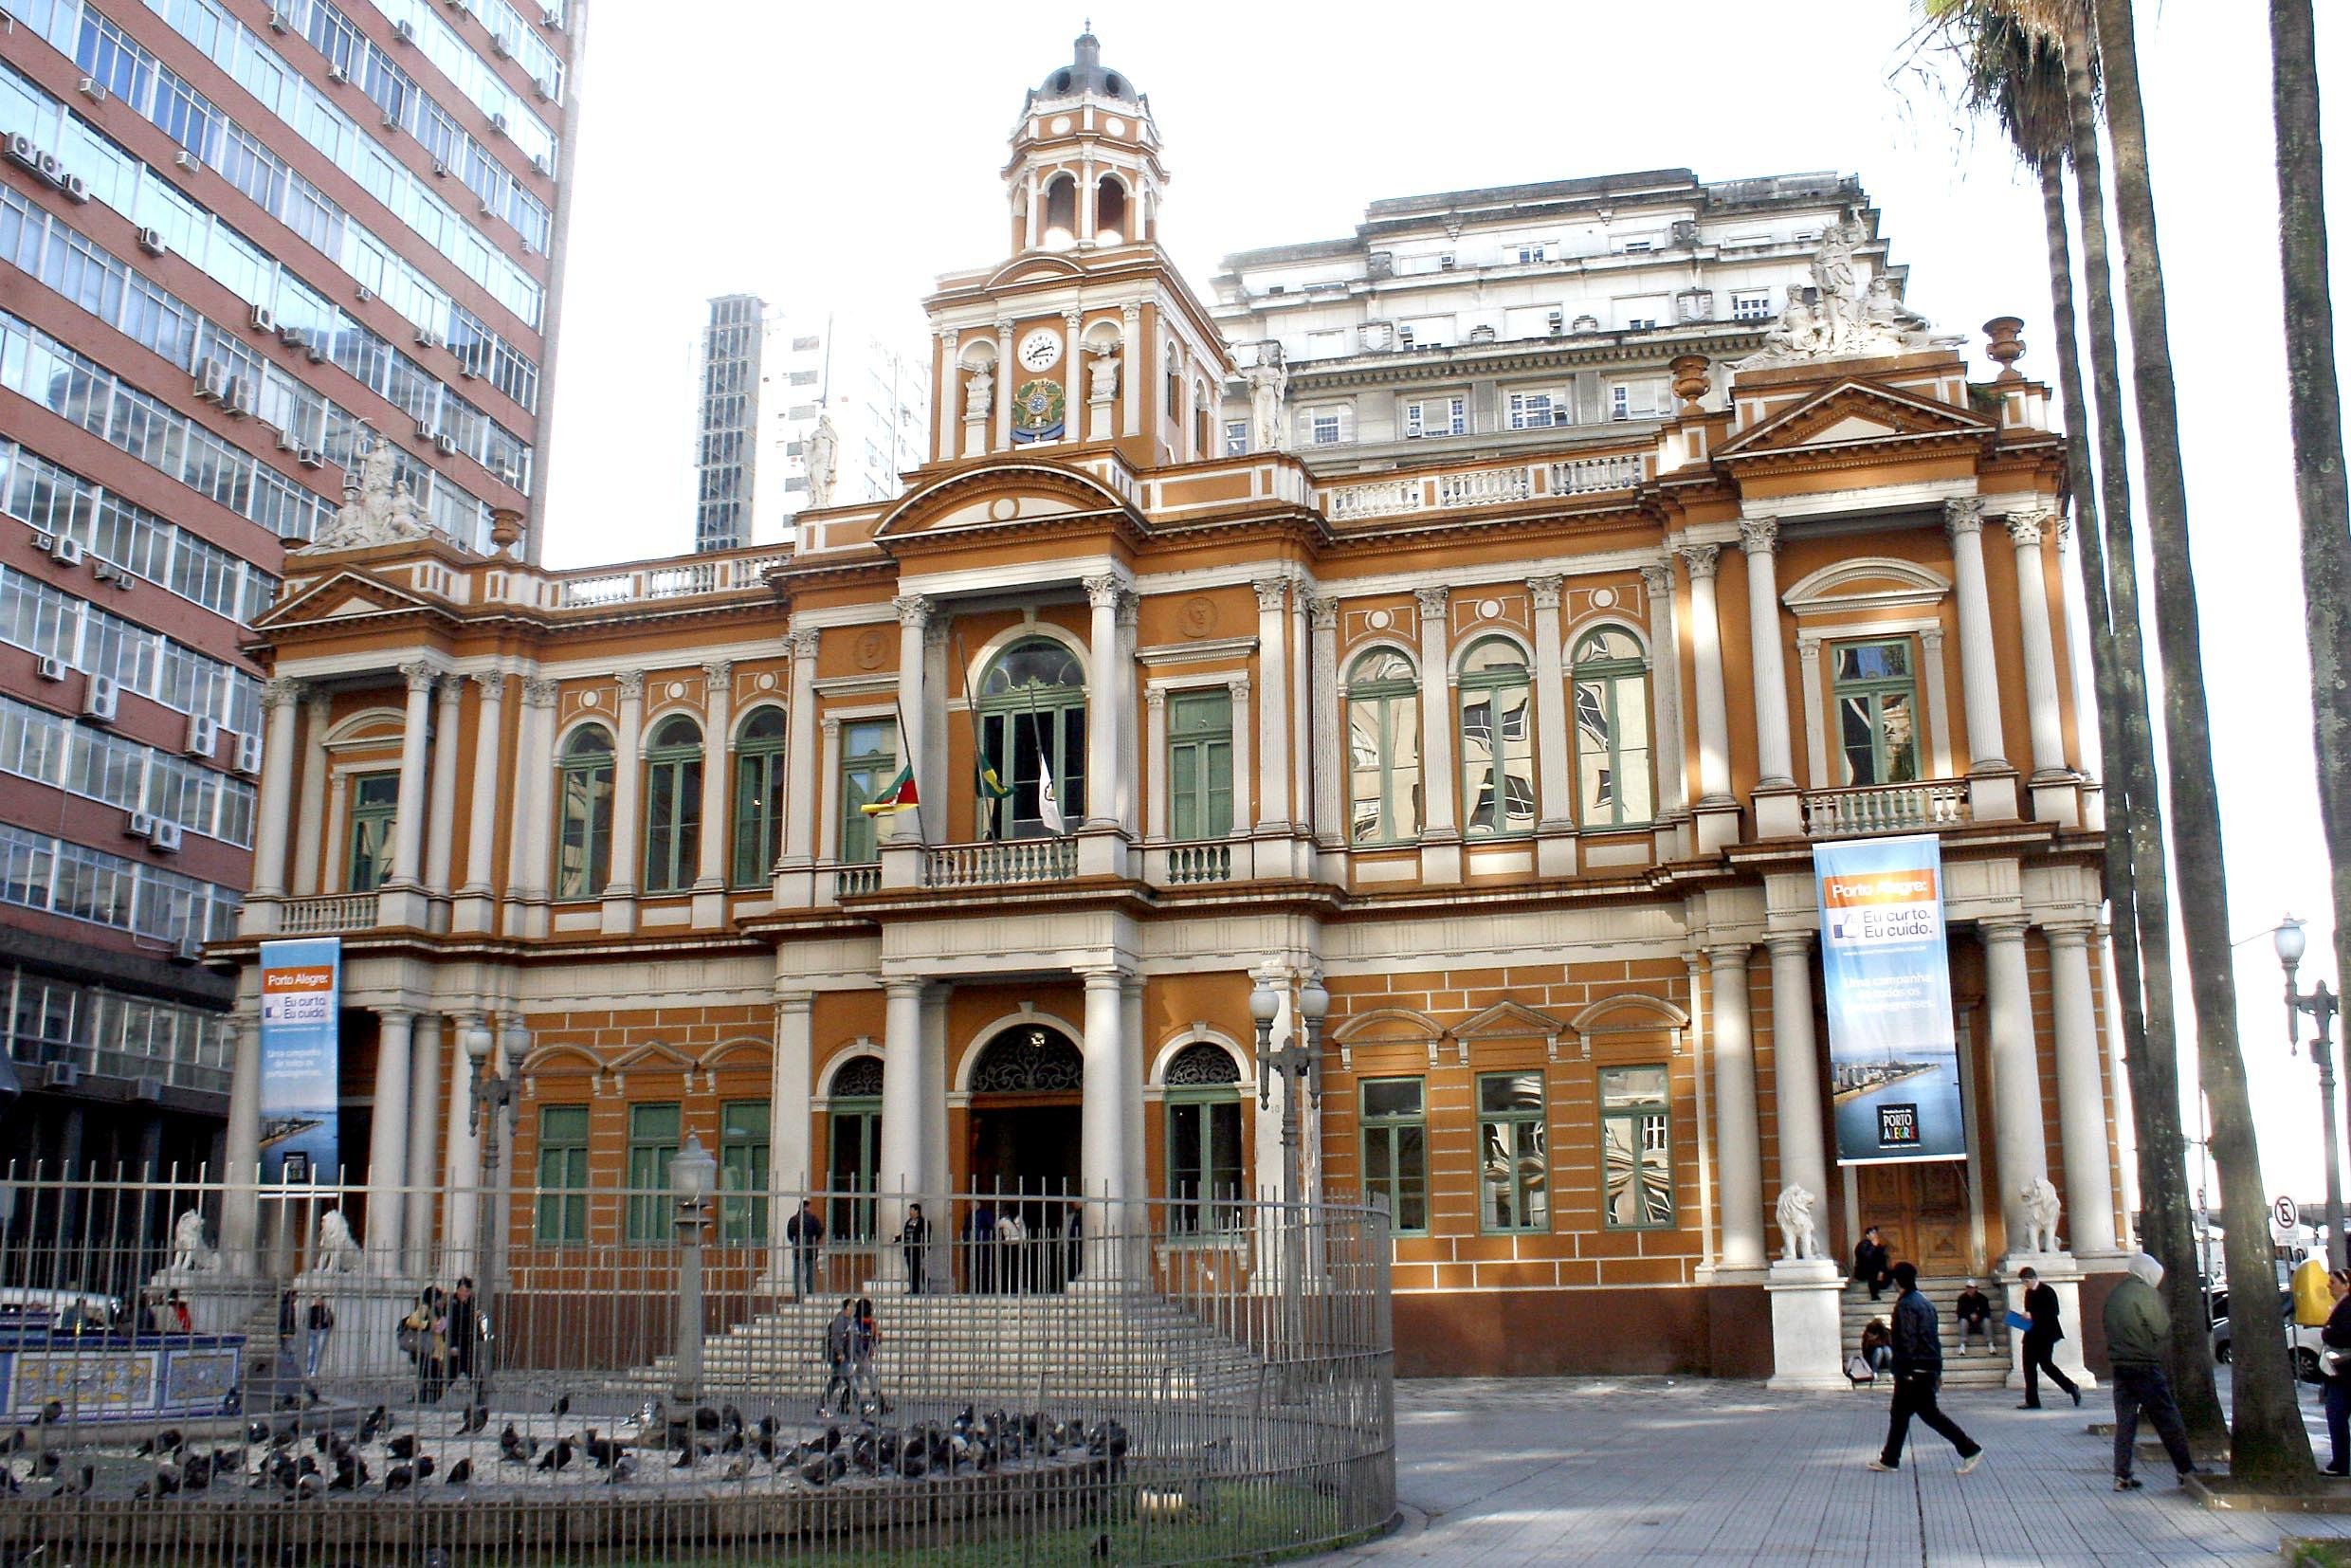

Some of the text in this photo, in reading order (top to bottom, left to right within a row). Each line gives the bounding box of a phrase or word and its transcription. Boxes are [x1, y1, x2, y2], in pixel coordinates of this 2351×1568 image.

[1832, 880, 1927, 899] Porto Alegre:
[1864, 908, 1931, 923] Eu curto.
[1865, 921, 1933, 939] Eu cuido.
[268, 975, 293, 986] Porto
[284, 996, 296, 1007] Eu
[284, 1009, 295, 1019] Eu
[1884, 1114, 1912, 1127] PORTO
[1884, 1125, 1917, 1140] ALEGRE
